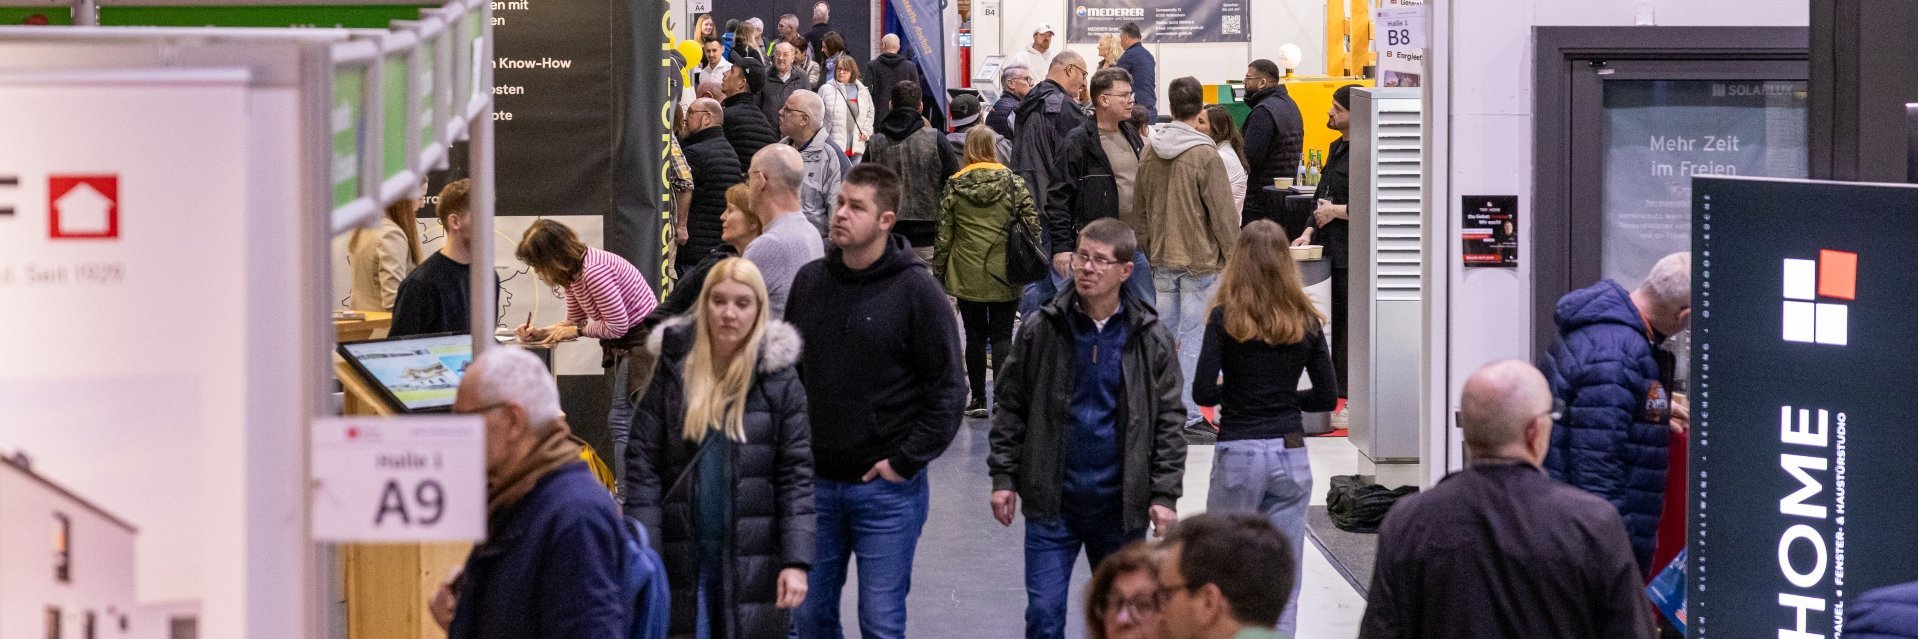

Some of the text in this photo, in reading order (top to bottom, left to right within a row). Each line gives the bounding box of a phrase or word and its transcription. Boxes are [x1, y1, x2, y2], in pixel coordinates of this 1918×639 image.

[508, 0, 529, 10] mit
[985, 8, 995, 16] B4
[1087, 7, 1145, 17] MEDERER
[1388, 29, 1410, 46] B8
[499, 57, 572, 69] Know-How
[1728, 84, 1793, 97] SOLARLUX
[1650, 135, 1740, 152] Mehr Zeit
[1651, 160, 1737, 176] im Freien
[1835, 411, 1847, 514] HAUSTÜRSTUDIO
[373, 478, 446, 528] A9
[1777, 405, 1829, 639] HOME
[1835, 515, 1845, 526] &
[1834, 527, 1845, 586] FENSTER-
